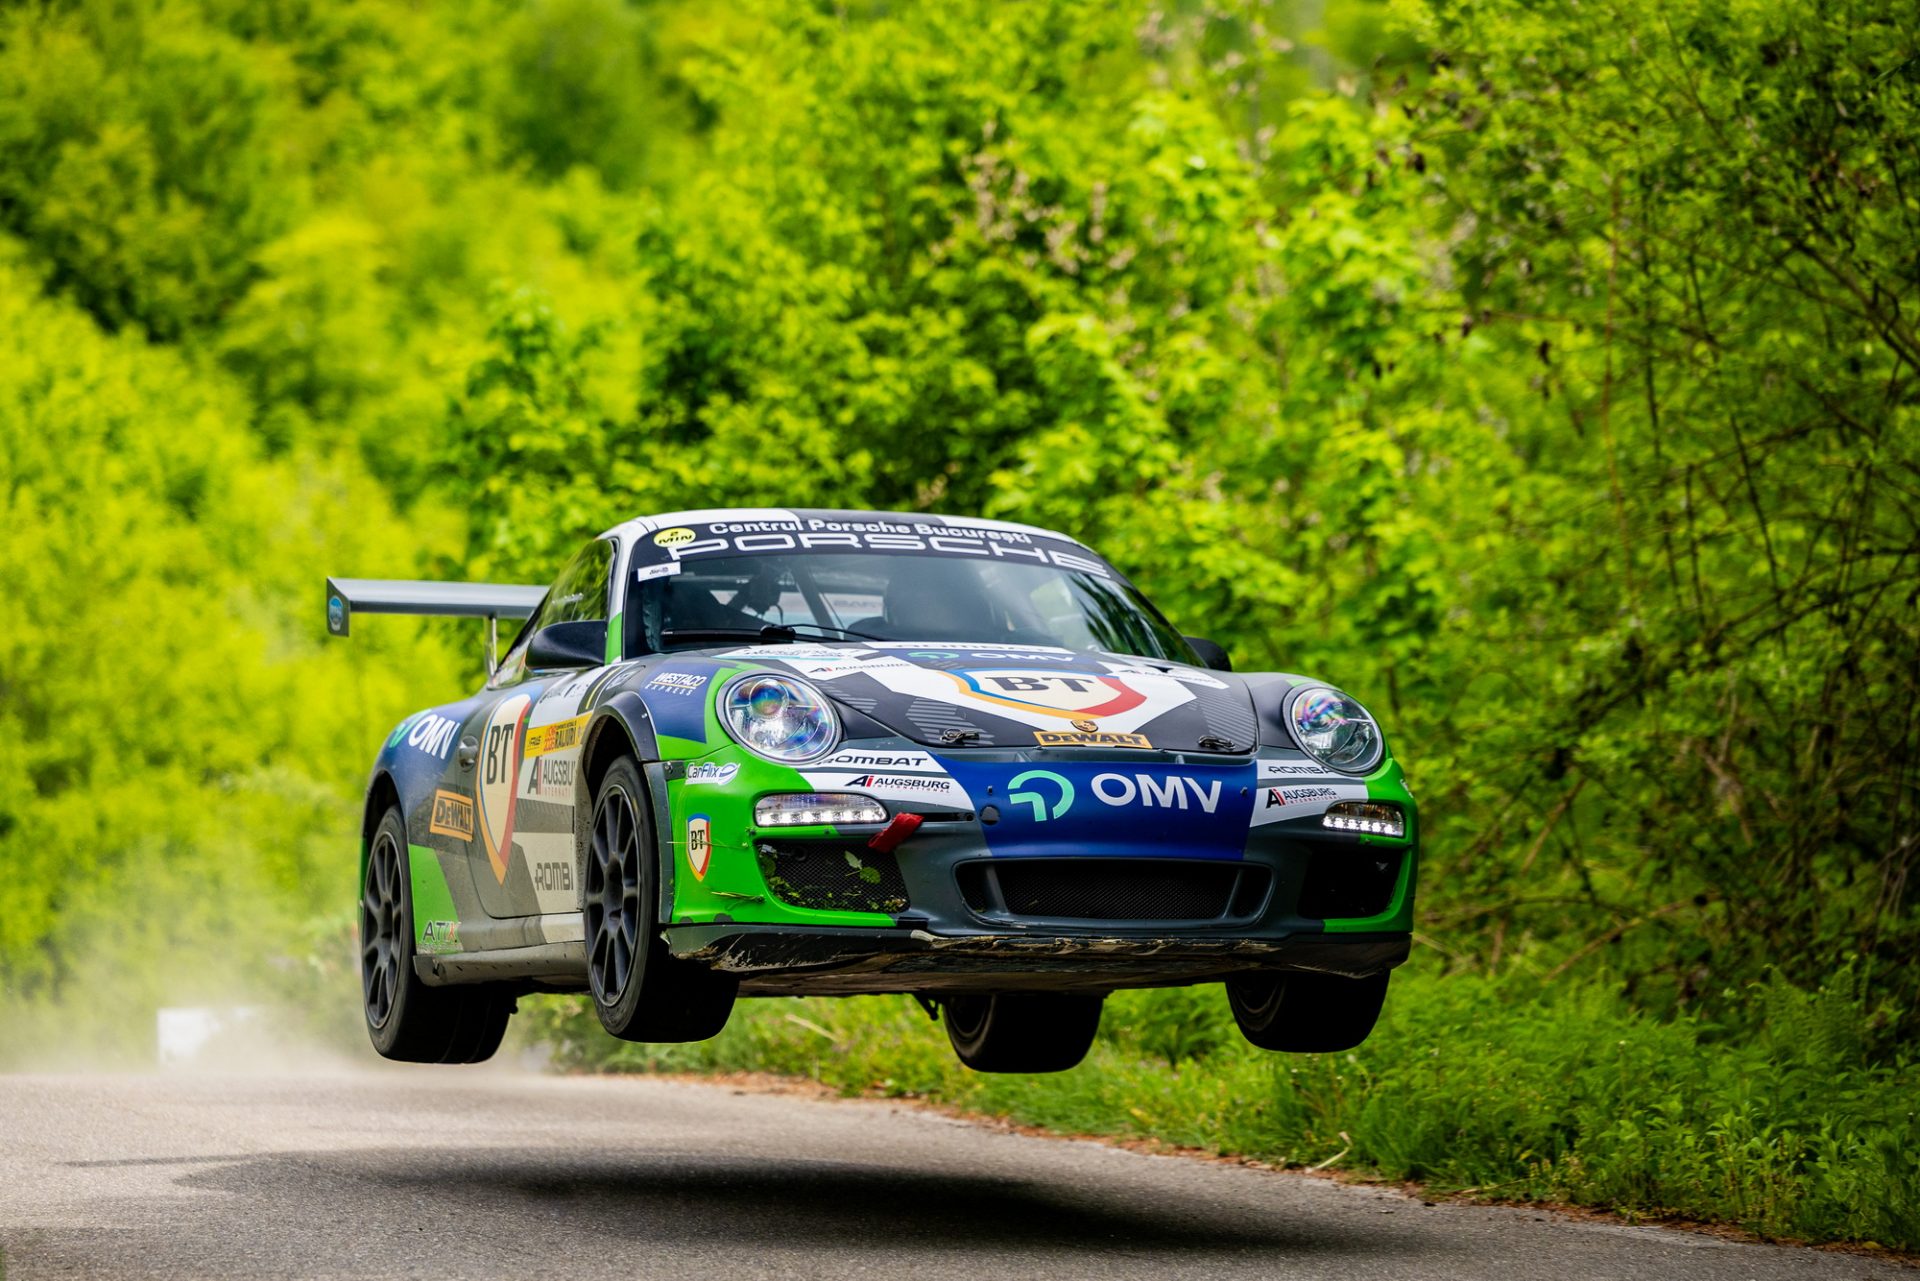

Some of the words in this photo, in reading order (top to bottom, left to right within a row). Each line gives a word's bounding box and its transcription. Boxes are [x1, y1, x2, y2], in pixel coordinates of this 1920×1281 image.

[709, 520, 805, 535] Centrul
[808, 519, 911, 535] Porsche
[658, 534, 692, 545] MIN
[667, 532, 1111, 578] PORSCHE
[970, 652, 1075, 663] OMV
[644, 683, 694, 696] EXPRESS
[985, 676, 1096, 693] BT
[408, 714, 461, 760] OMV
[486, 723, 516, 785] BT
[542, 759, 577, 787] AUGSBU
[874, 777, 951, 790] AUGSBURG
[1090, 772, 1223, 814] OMV
[1282, 787, 1337, 801] AUGSBURG
[690, 829, 705, 851] BT
